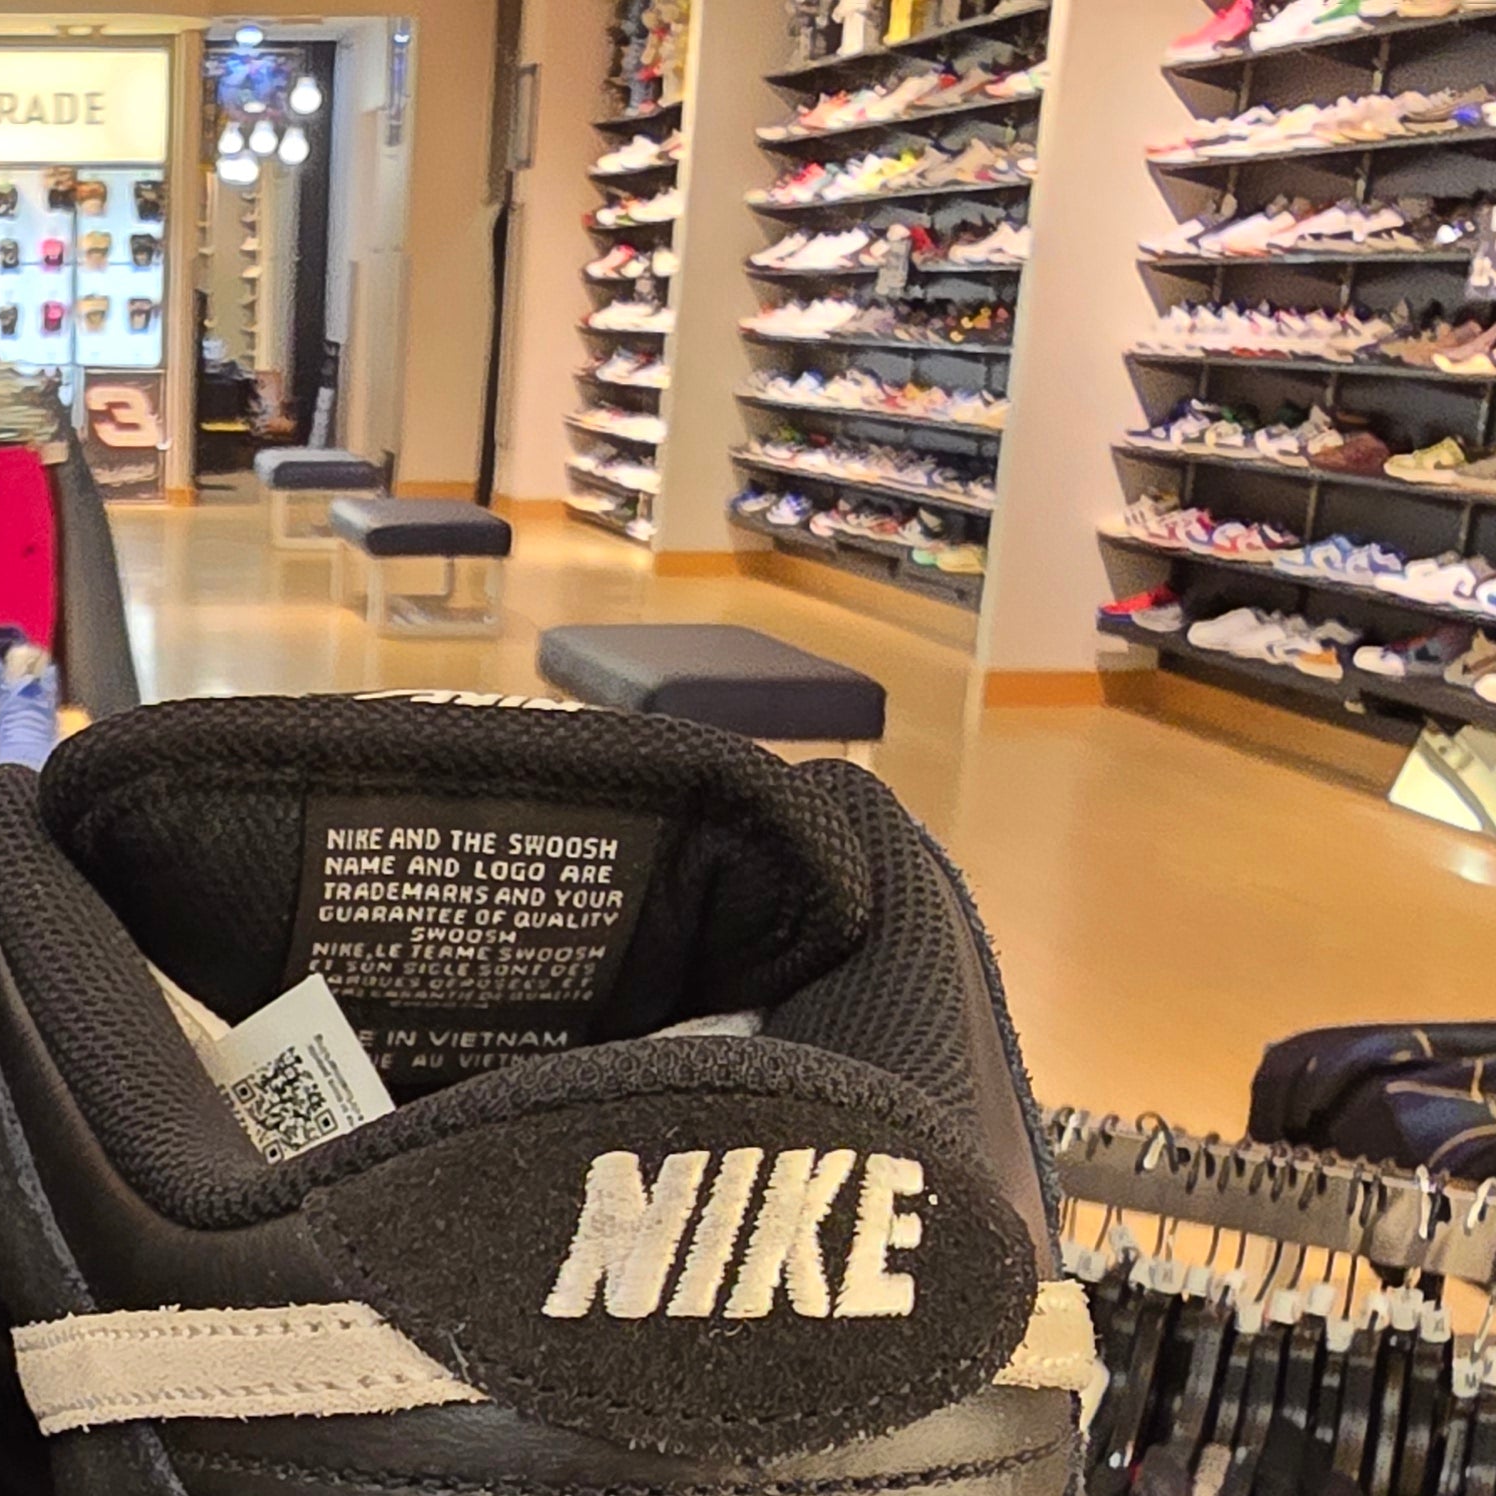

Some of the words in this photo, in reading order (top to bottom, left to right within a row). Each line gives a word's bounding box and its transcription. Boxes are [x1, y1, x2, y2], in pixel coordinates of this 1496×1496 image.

[327, 828, 384, 850] NIKE
[389, 827, 441, 851] AND
[450, 830, 497, 854] THE
[509, 833, 618, 860] SWOOSH
[324, 855, 396, 876] NAME
[407, 855, 460, 878] AND
[474, 860, 546, 881] LOGO
[559, 865, 613, 884] ARE
[324, 882, 489, 904] TRADEMARKS
[494, 887, 546, 906] AND
[555, 889, 623, 908] YOUR
[318, 905, 468, 925] GUARANTEE
[475, 908, 507, 926] OF
[514, 910, 619, 929] QUALITY
[409, 926, 517, 944] SWOOSH
[498, 946, 606, 963] SWOOSH
[387, 1030, 417, 1046] IN
[429, 1031, 568, 1047] VIETNAM
[411, 1054, 443, 1069] AU
[541, 1147, 924, 1318] NIKE
